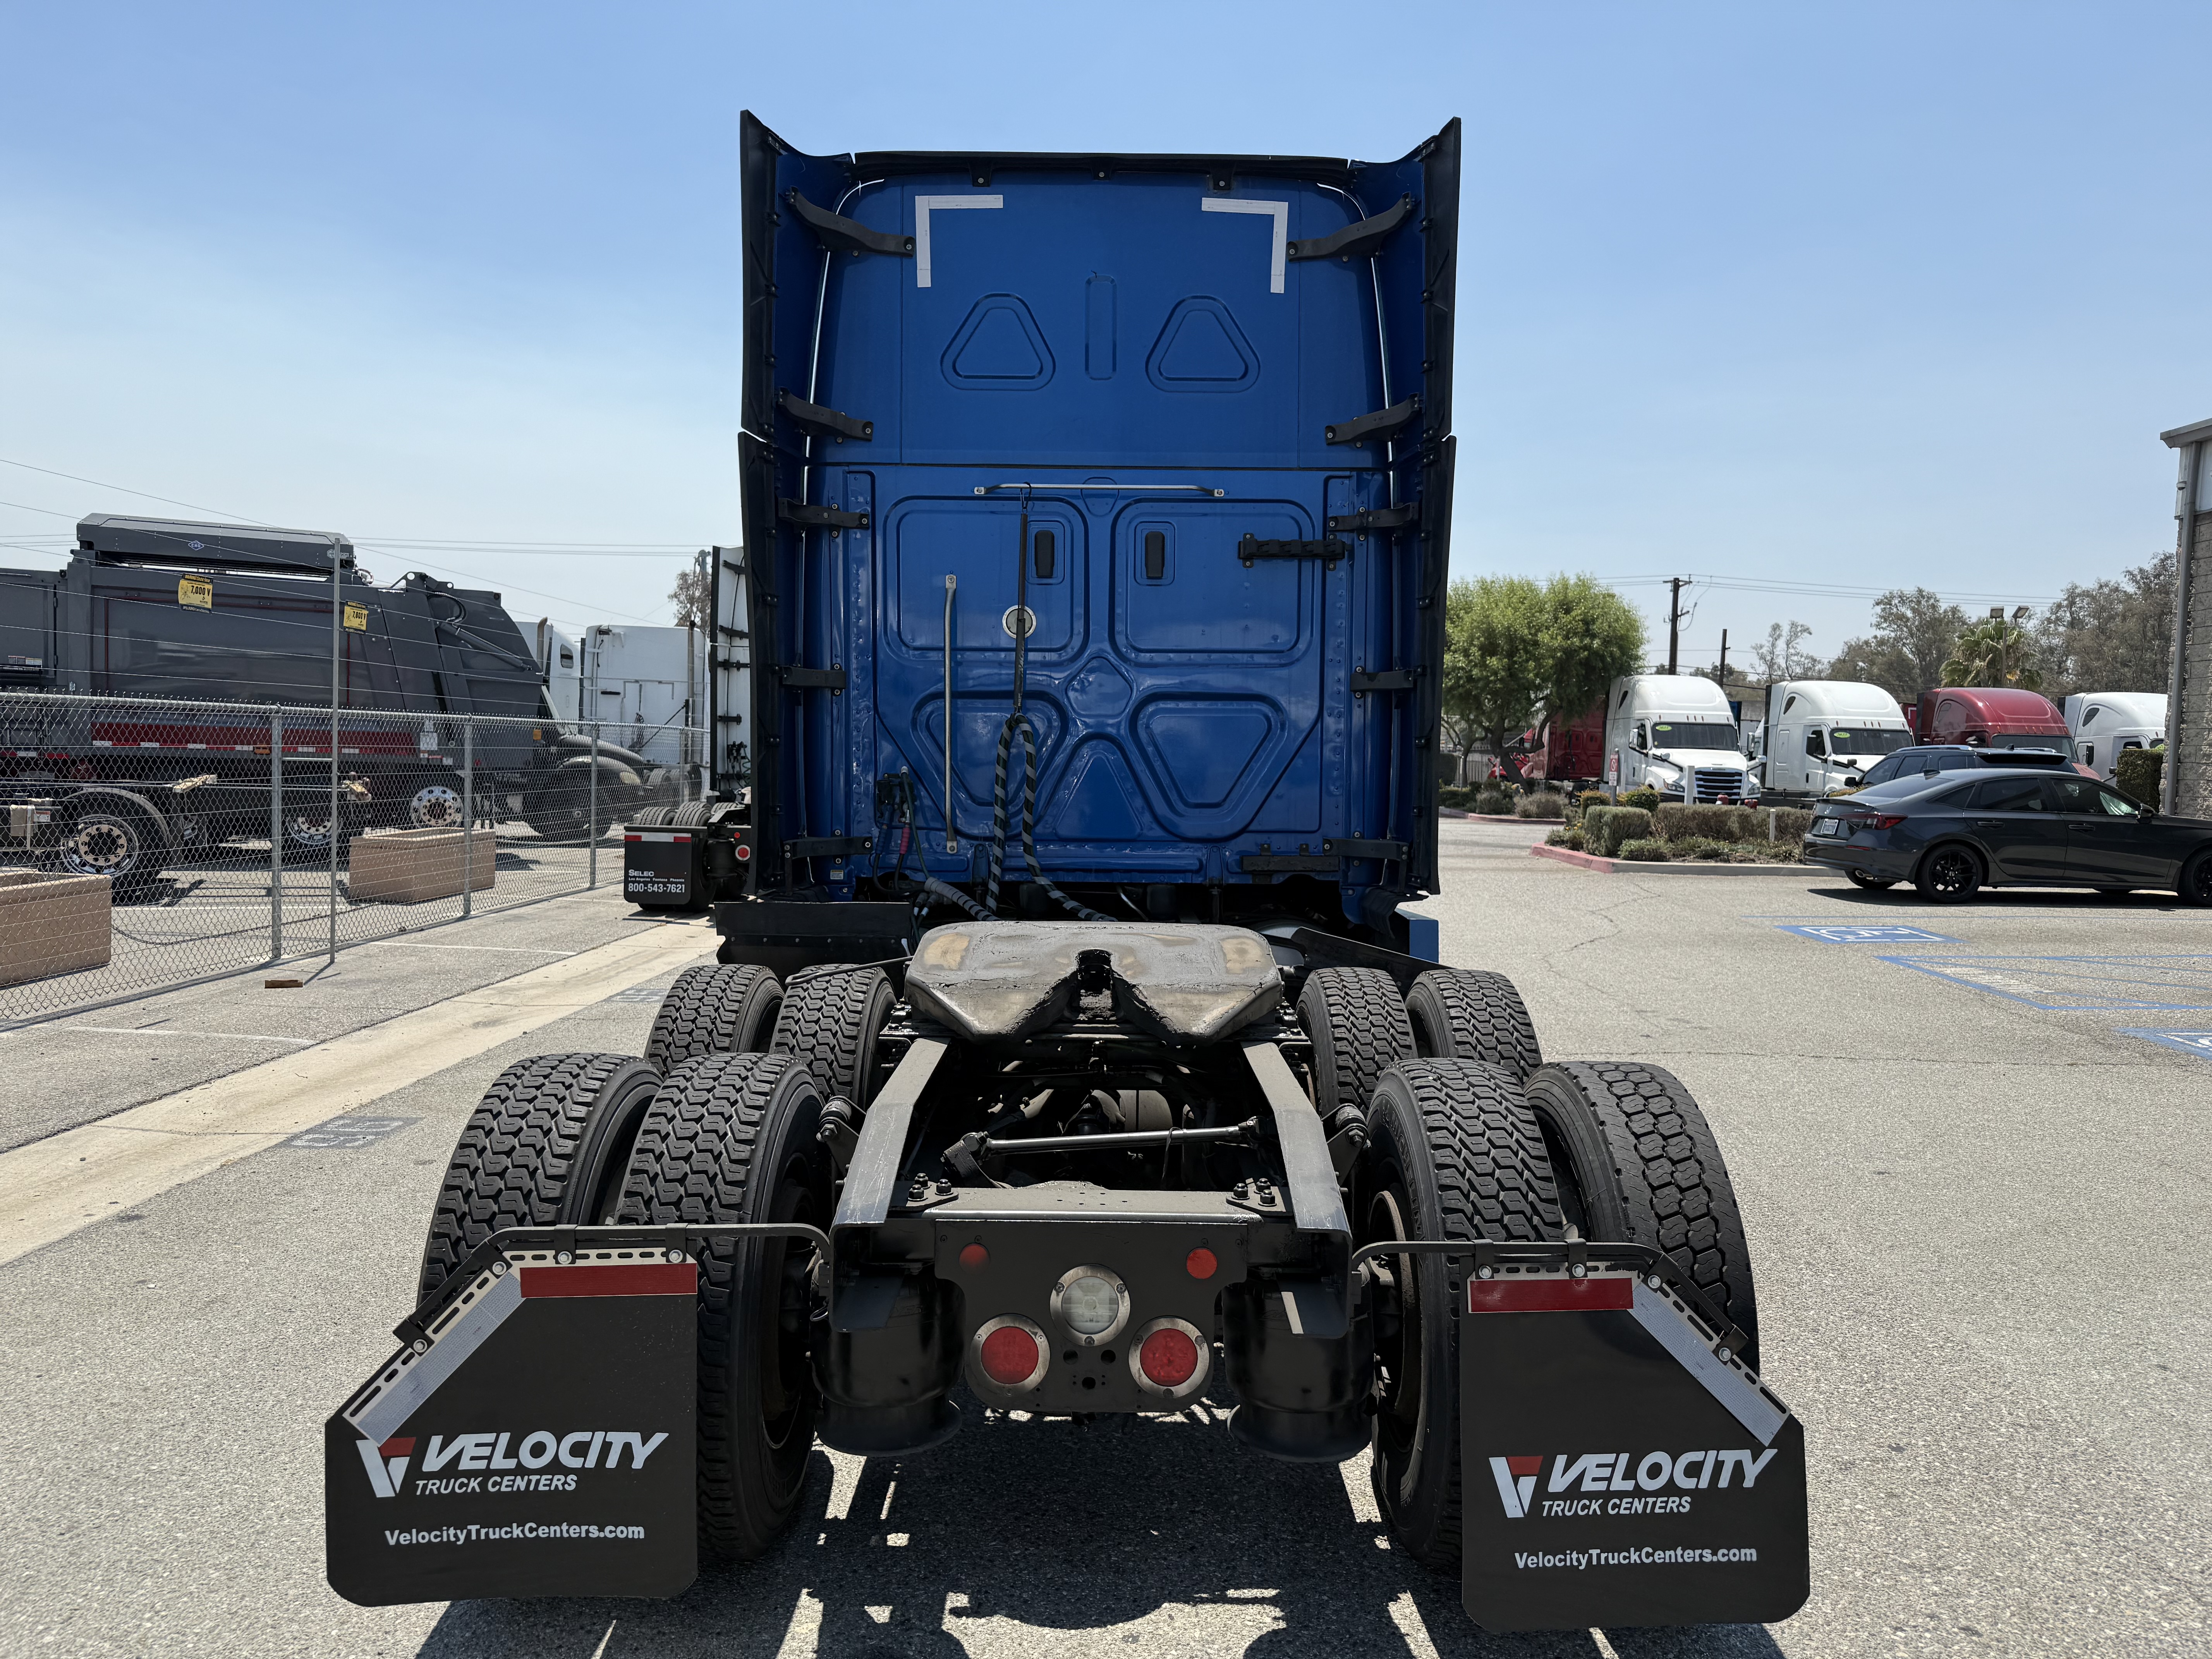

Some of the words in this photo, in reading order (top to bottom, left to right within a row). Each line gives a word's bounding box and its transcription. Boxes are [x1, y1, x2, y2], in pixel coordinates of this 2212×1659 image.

[191, 585, 206, 596] 7,000
[207, 588, 211, 596] V
[628, 883, 685, 893] 800-543-7621
[422, 1431, 669, 1472] VELOCITY
[1547, 1449, 1778, 1492] VELOCITY
[416, 1477, 482, 1495] TRUCK
[488, 1474, 578, 1492] CENTERS
[1542, 1499, 1603, 1517] TRUCK
[1607, 1496, 1692, 1515] CENTERS
[385, 1522, 645, 1546] VelocityTruckCenters.com
[1515, 1546, 1757, 1570] VelocityTruckCenters.com
